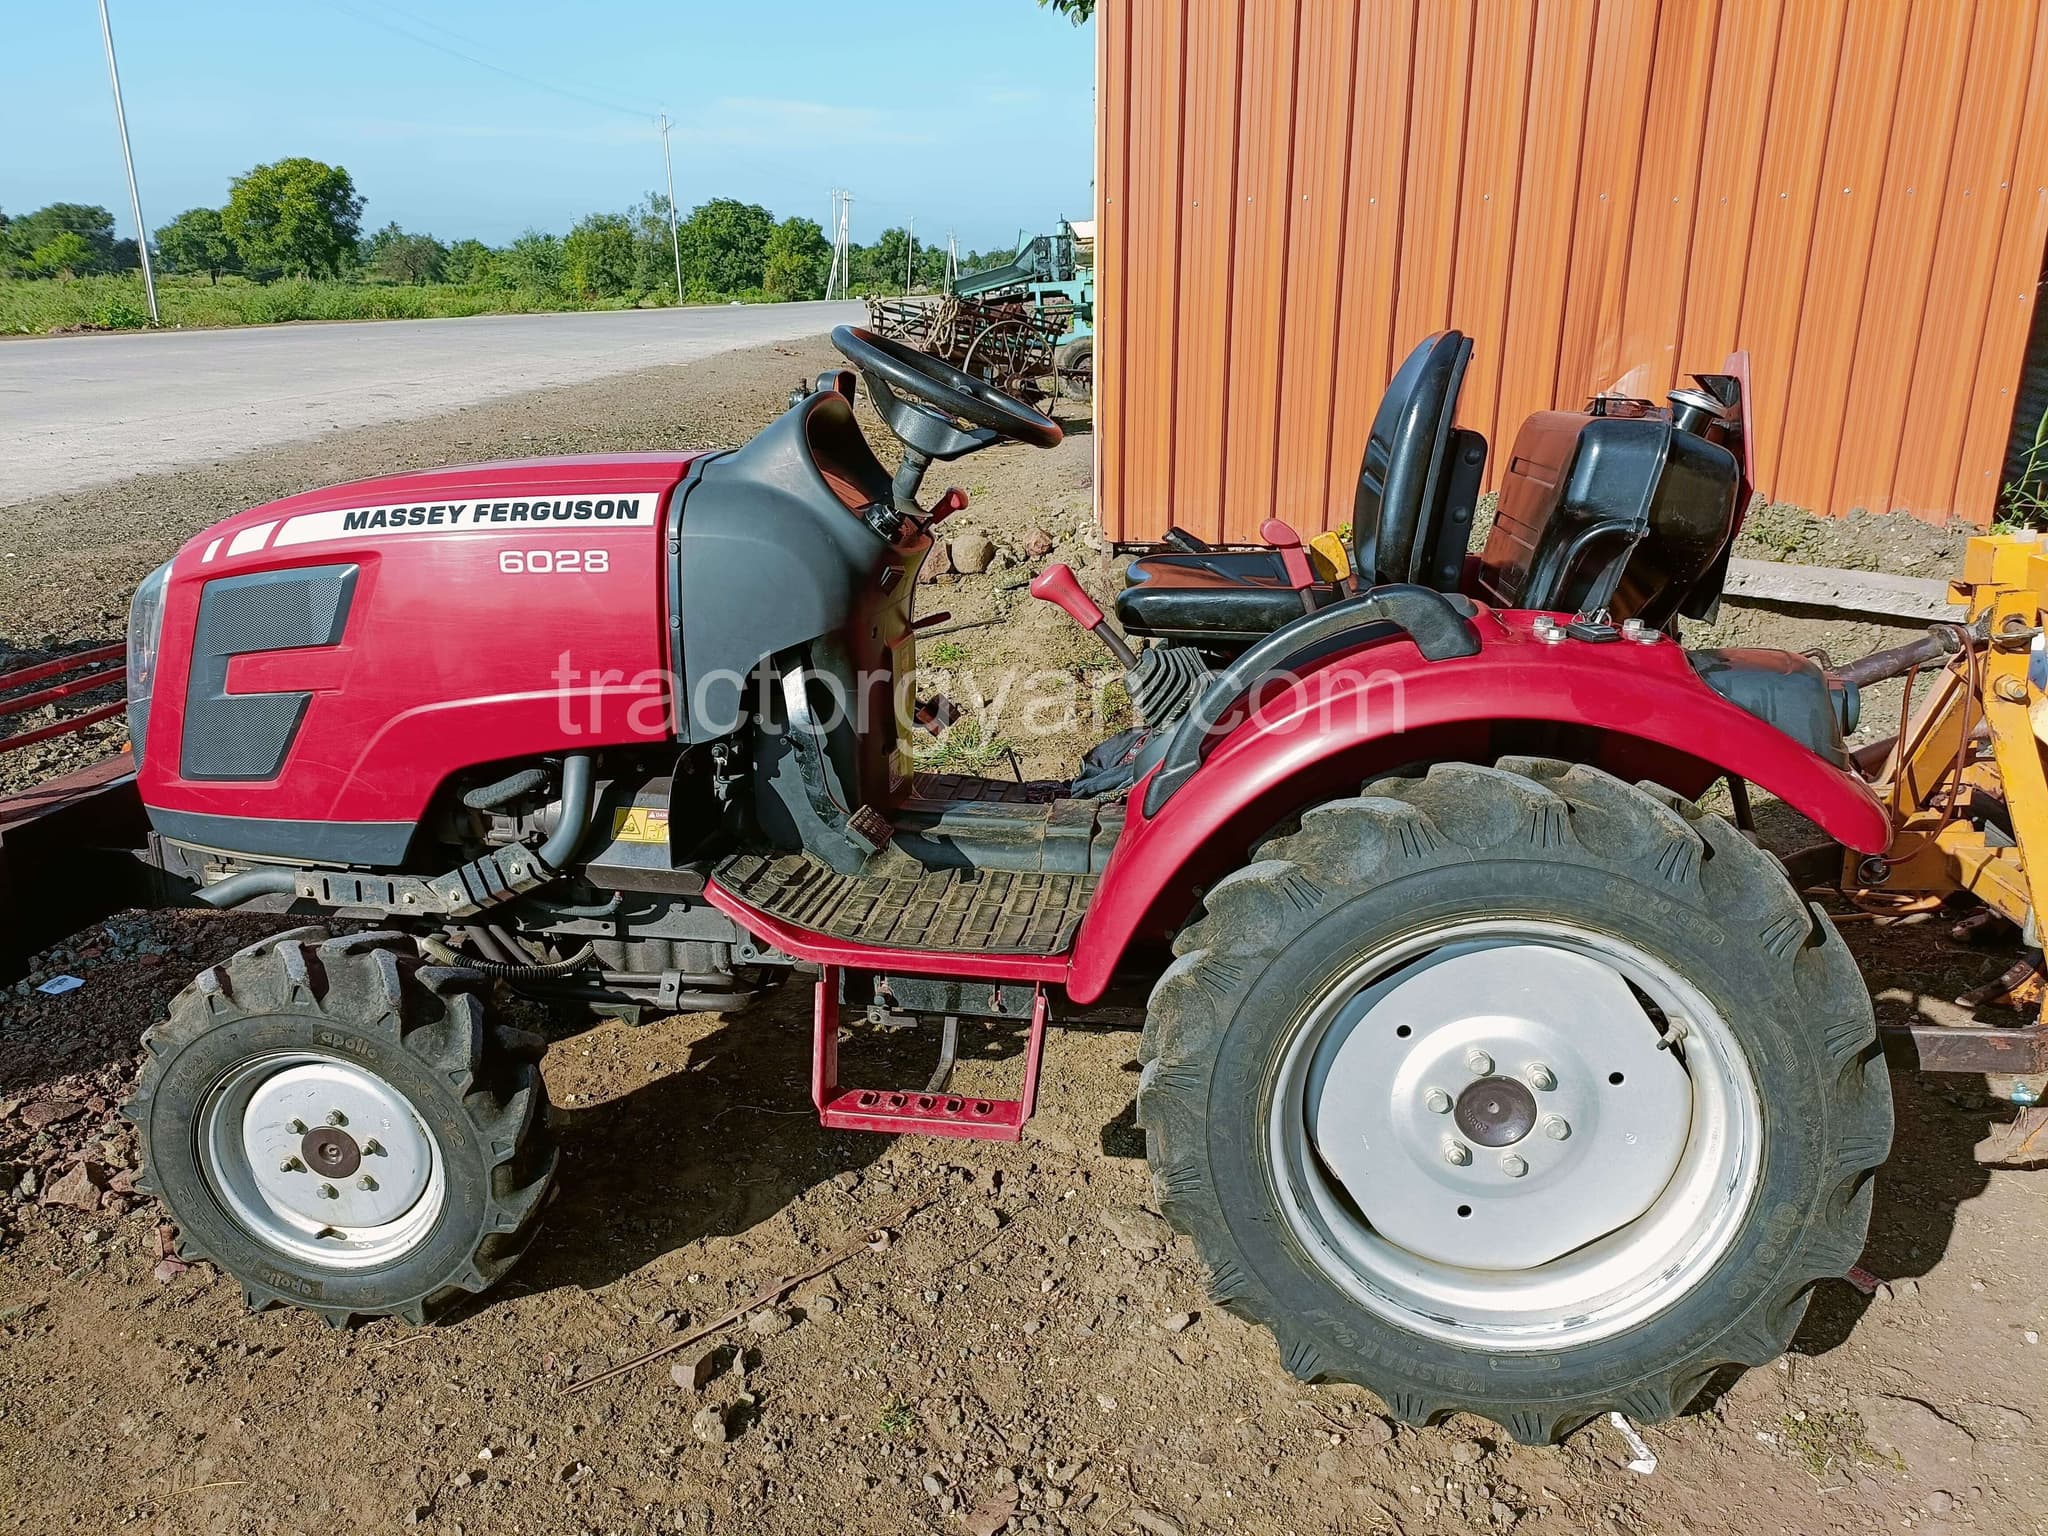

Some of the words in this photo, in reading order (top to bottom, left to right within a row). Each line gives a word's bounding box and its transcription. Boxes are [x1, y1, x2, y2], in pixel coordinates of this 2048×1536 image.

[343, 504, 467, 530] MASSEY
[473, 499, 640, 523] FERGUSON
[499, 550, 609, 573] 6028
[320, 1031, 378, 1059] apollo
[260, 1268, 312, 1295] apollo
